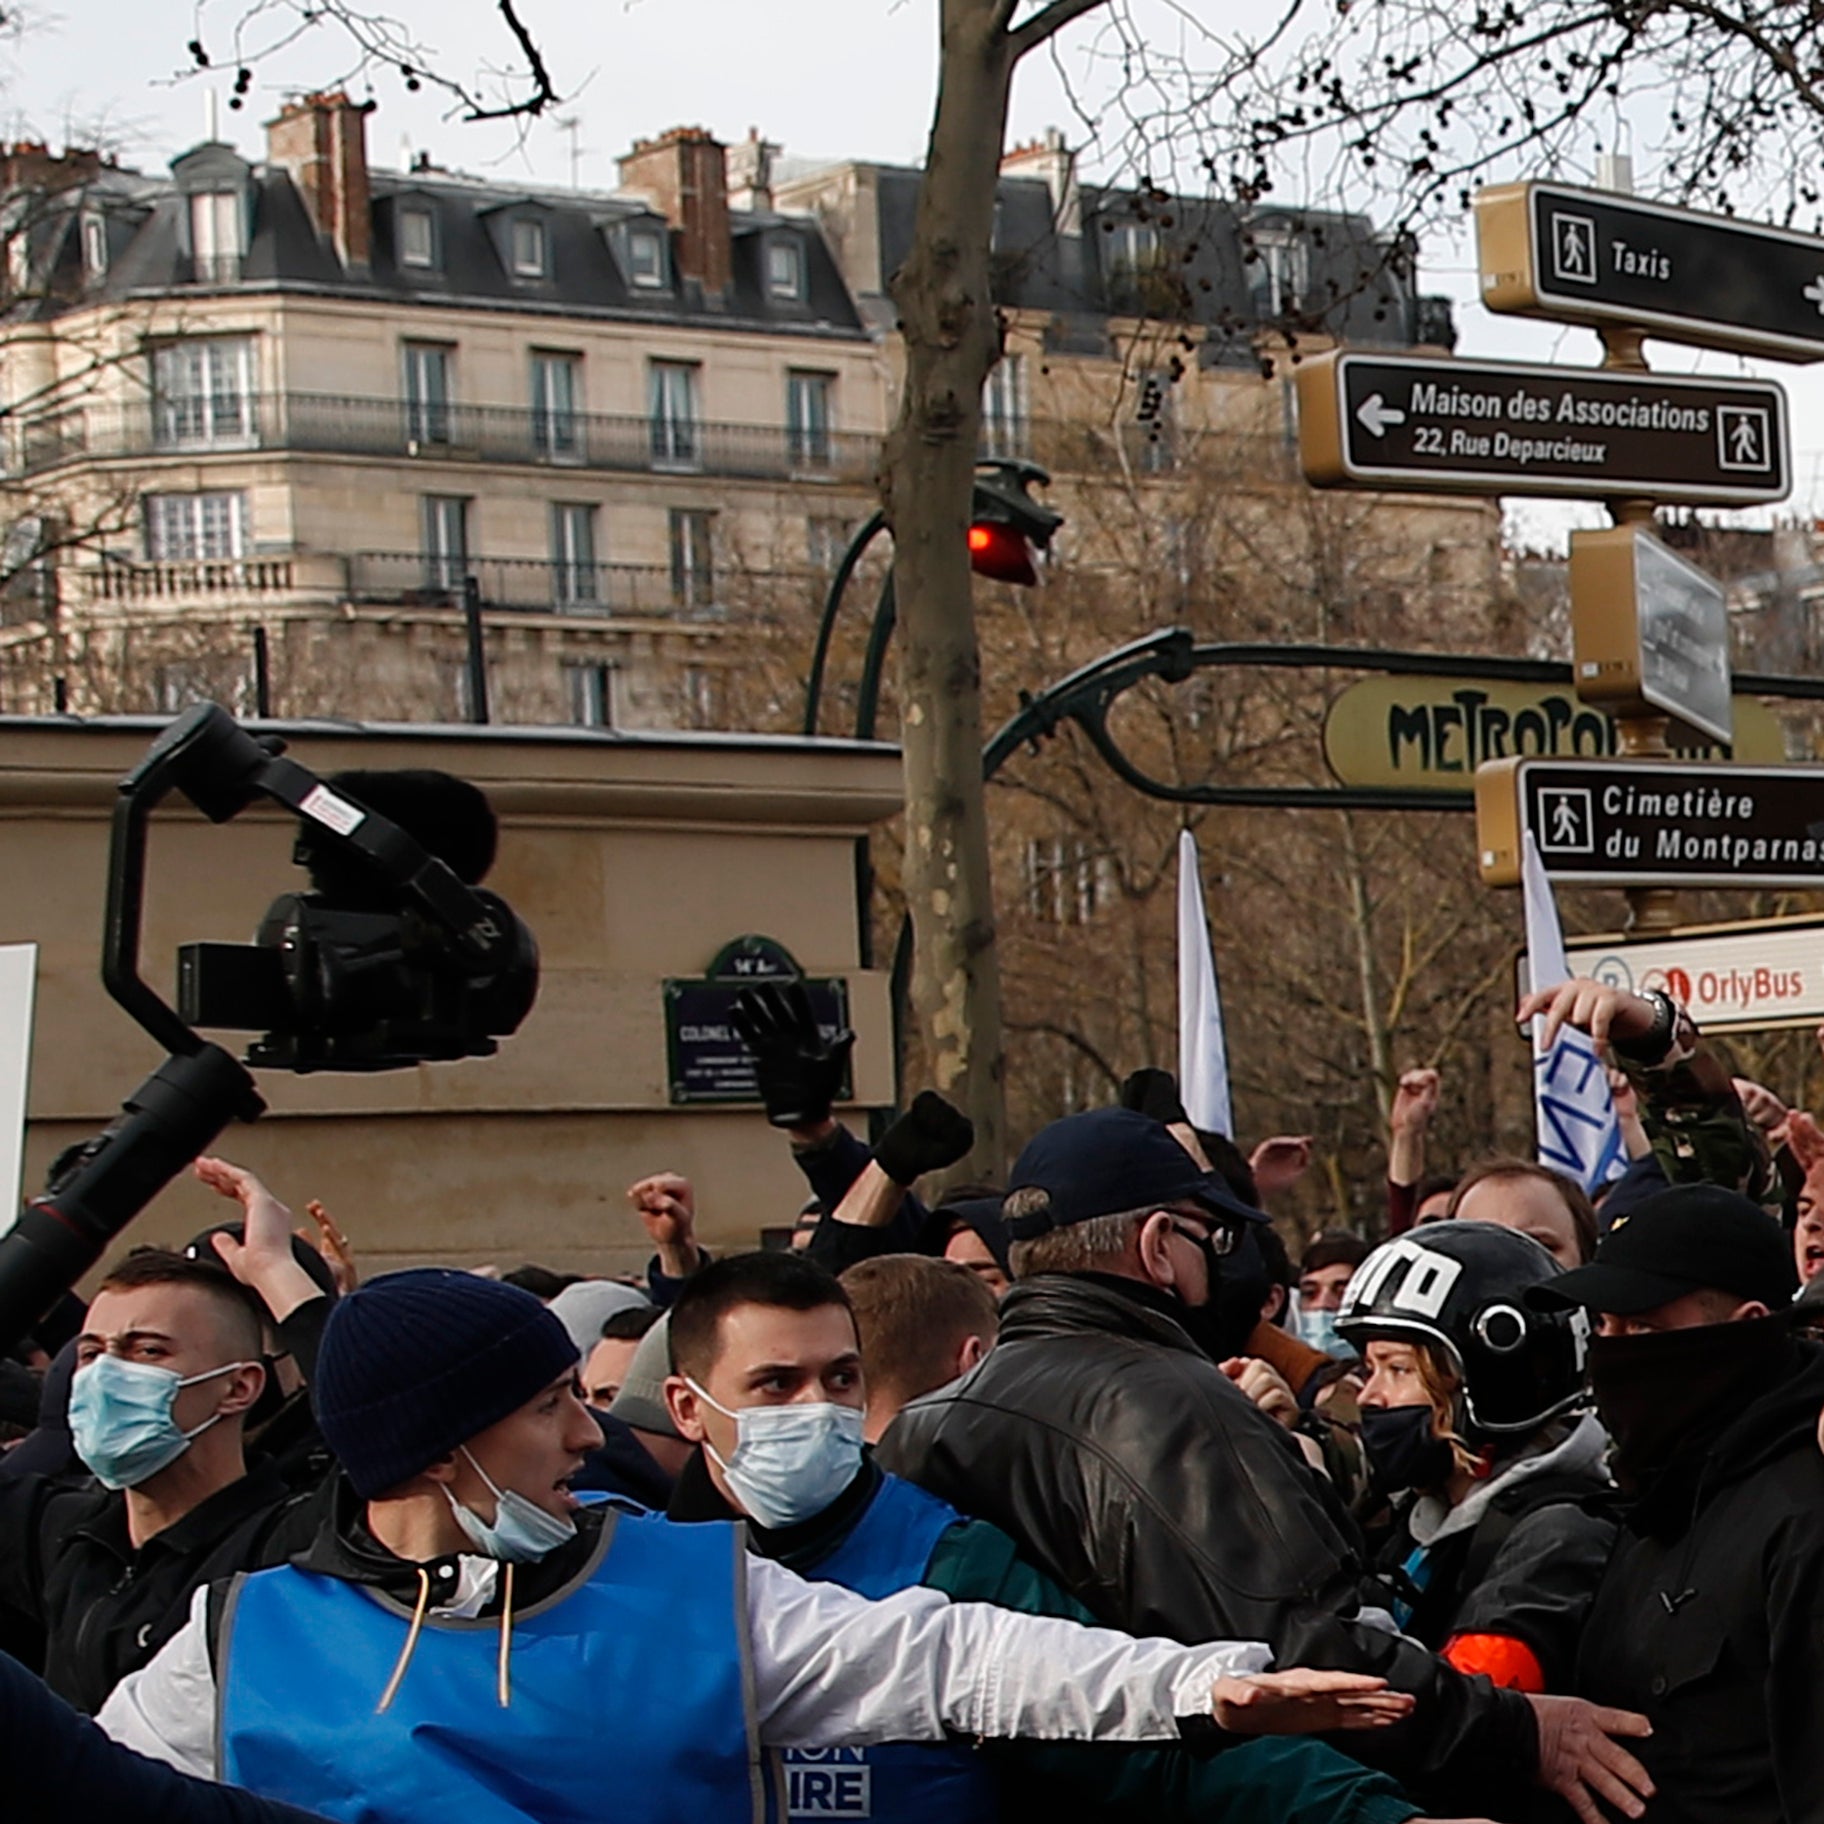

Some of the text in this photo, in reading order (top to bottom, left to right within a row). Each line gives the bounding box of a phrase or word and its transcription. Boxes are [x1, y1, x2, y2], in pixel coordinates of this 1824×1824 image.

[1611, 240, 1671, 281] Taxis
[1411, 382, 1711, 433] Maison des Associations
[1412, 428, 1608, 465] 22, Rue Deparcieux
[1602, 784, 1755, 821] Cimetière
[1605, 830, 1643, 860] du
[1697, 966, 1804, 1009] OrlyBus
